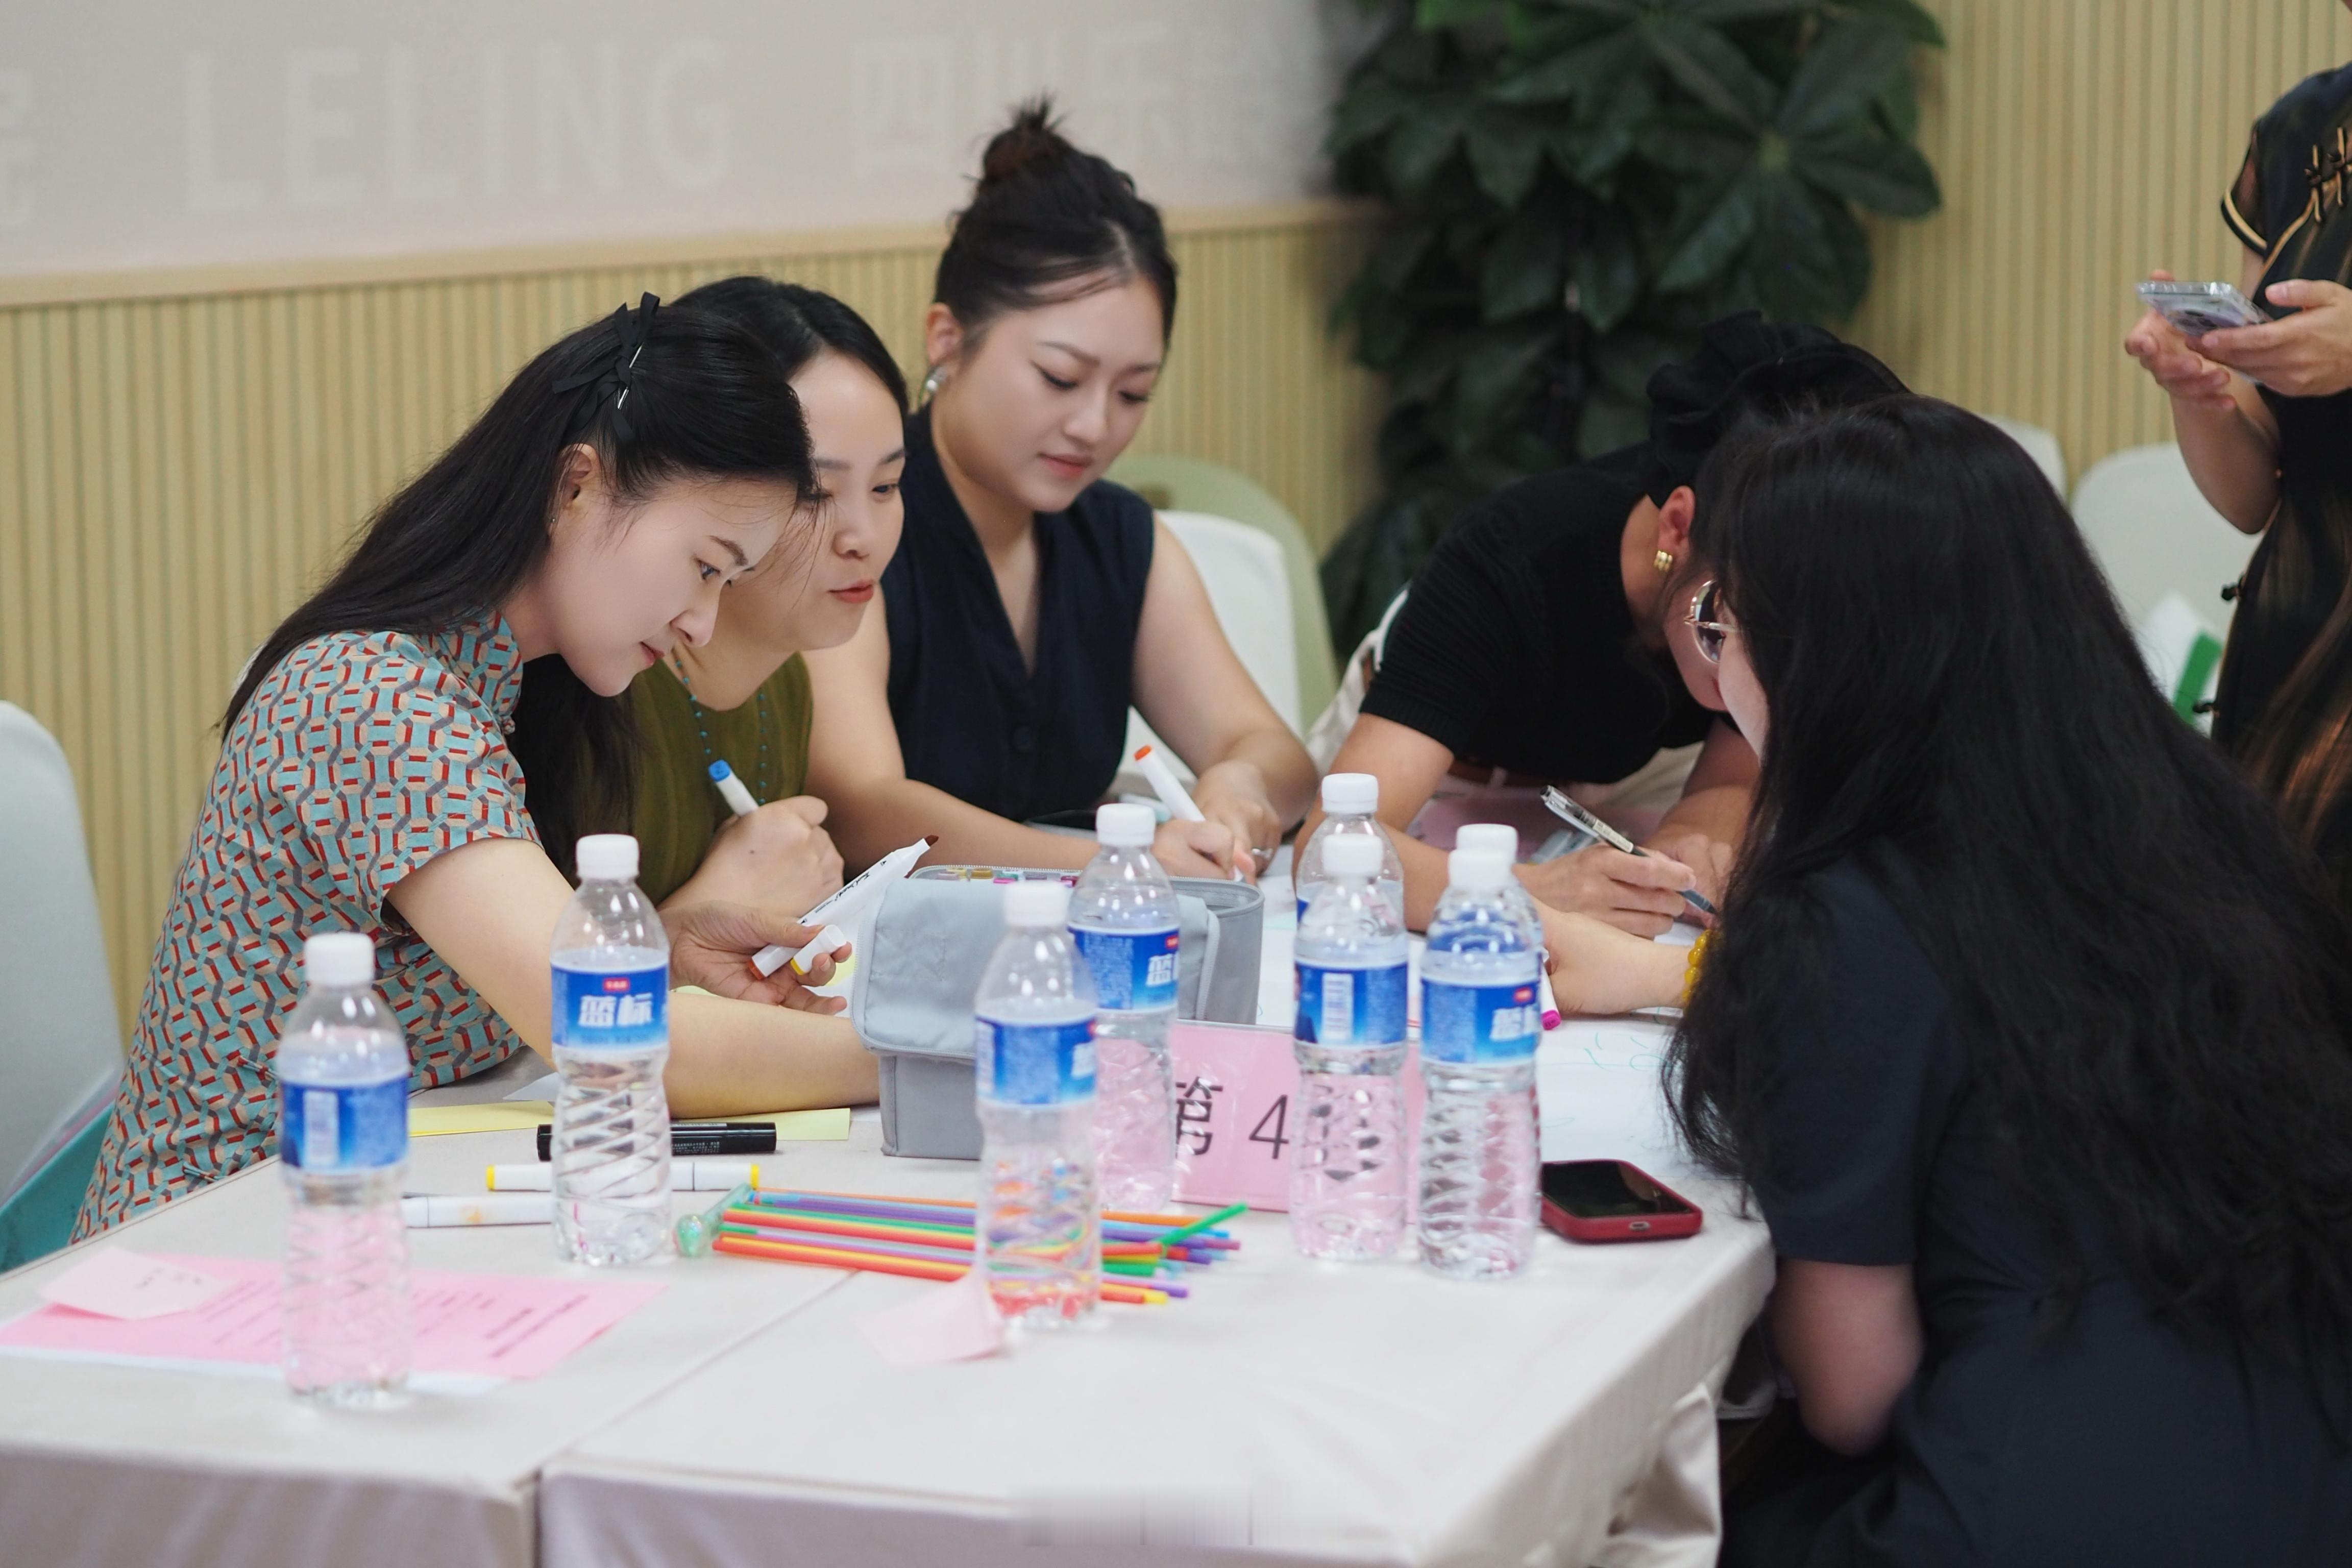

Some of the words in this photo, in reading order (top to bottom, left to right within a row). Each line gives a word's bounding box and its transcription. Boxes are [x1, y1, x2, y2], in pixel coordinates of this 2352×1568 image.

[185, 36, 732, 212] LELING
[1175, 1076, 1223, 1159] 第
[1249, 1094, 1289, 1160] 4
